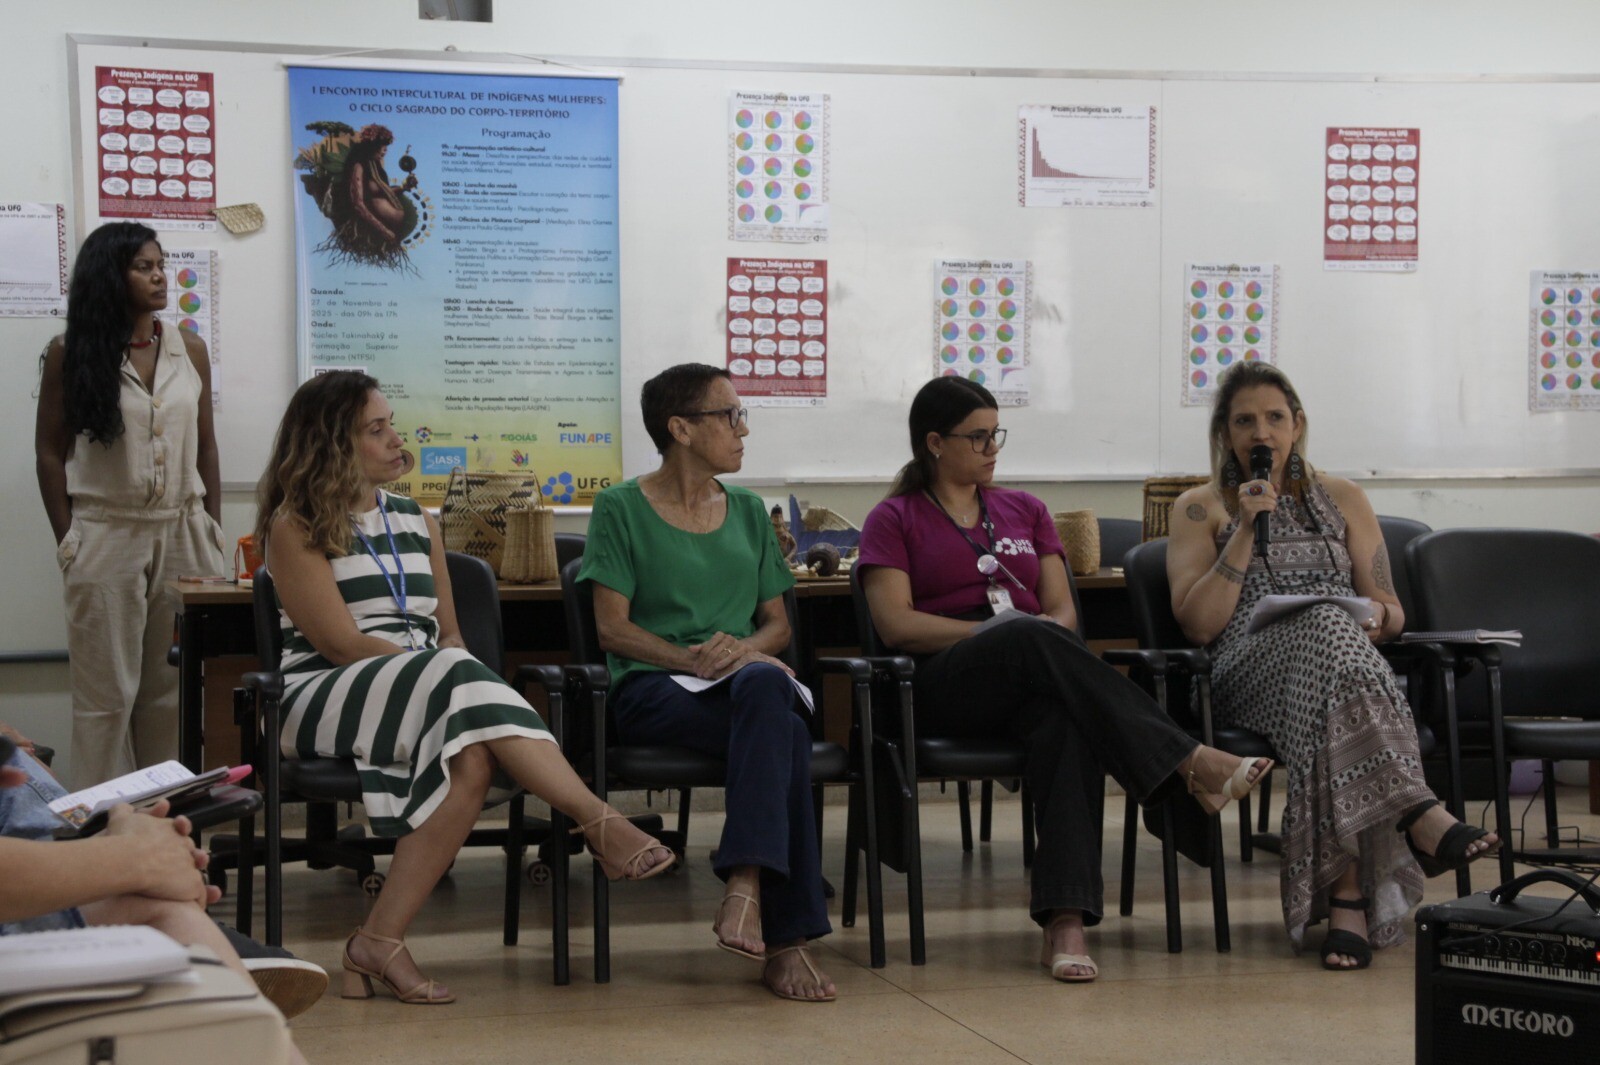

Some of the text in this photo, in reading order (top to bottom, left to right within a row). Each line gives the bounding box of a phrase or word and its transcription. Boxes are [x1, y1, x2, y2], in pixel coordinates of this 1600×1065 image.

[110, 70, 142, 80] Presença
[143, 72, 174, 82] Indígena
[320, 86, 378, 96] ENCONTRO
[381, 88, 466, 100] INTERCULTURAL
[470, 92, 484, 100] DE
[488, 92, 544, 102] INDÍGENAS
[548, 94, 606, 105] MULHERES:
[736, 92, 762, 101] Presença
[763, 94, 788, 102] Indígena
[349, 103, 570, 118] O CICLO SAGRADO DO CORPO-TERRITÓRIO
[482, 128, 551, 140] Programação
[508, 433, 537, 441] GOIÁS
[560, 433, 612, 443] FUNAPE
[577, 478, 610, 489] UFG
[1462, 1004, 1574, 1037] METEORO
